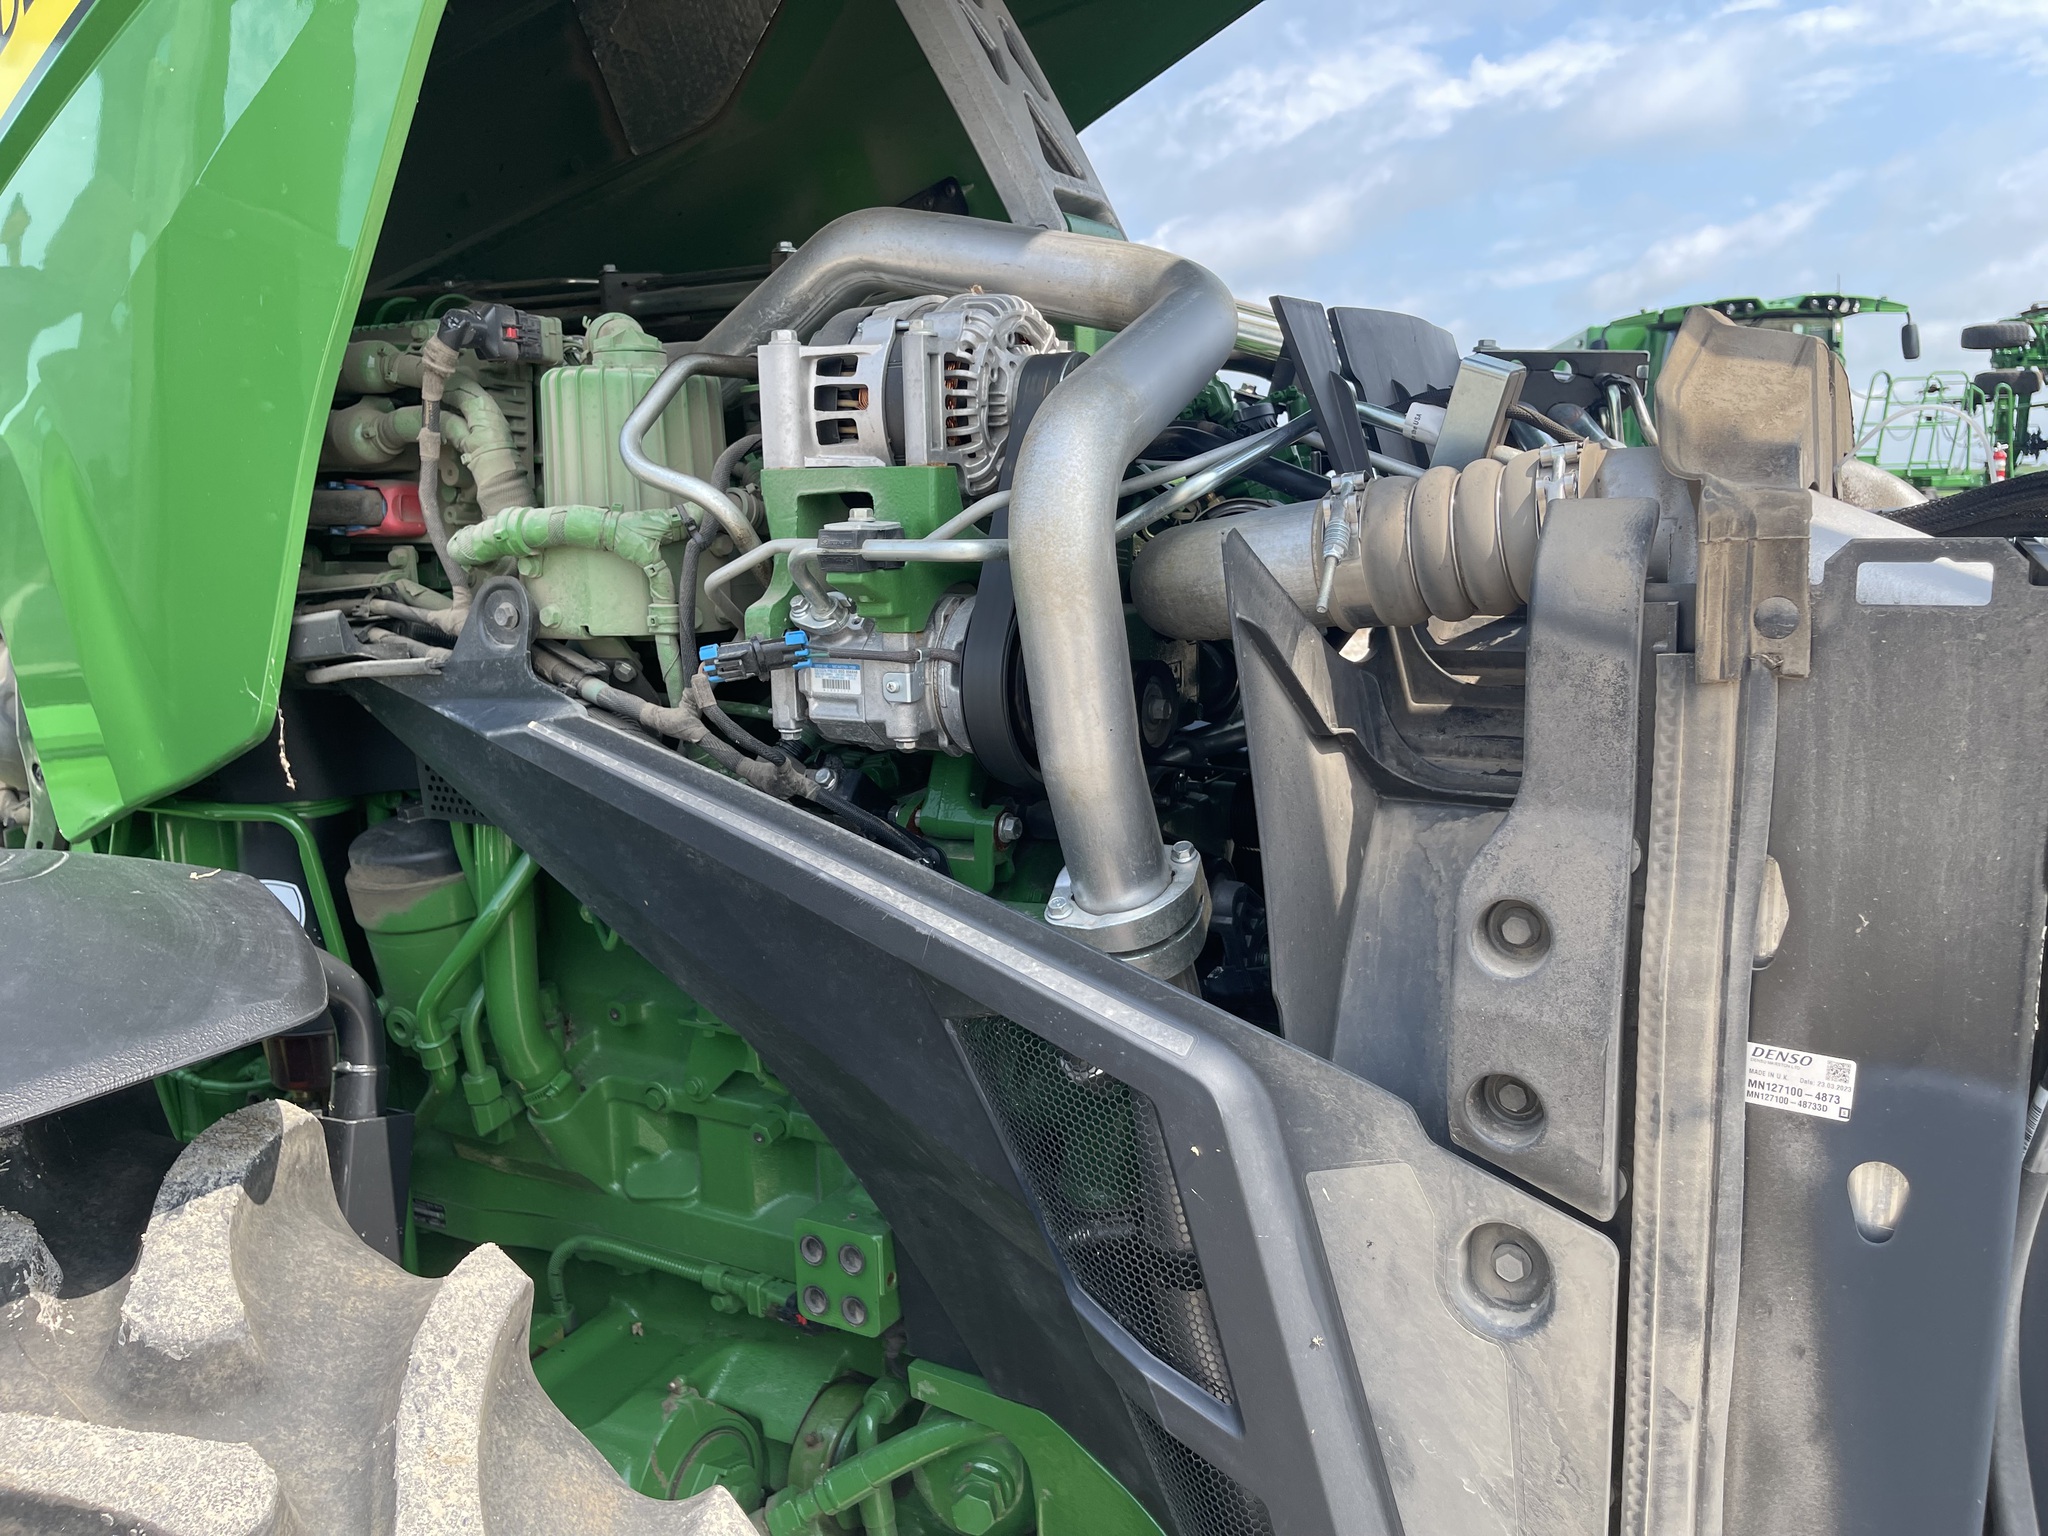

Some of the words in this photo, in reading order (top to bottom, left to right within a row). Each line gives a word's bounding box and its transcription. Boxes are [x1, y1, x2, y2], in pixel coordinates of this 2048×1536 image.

[1413, 413, 1422, 425] USA
[1751, 1046, 1813, 1066] DENSO
[1748, 1068, 1766, 1077] MADE
